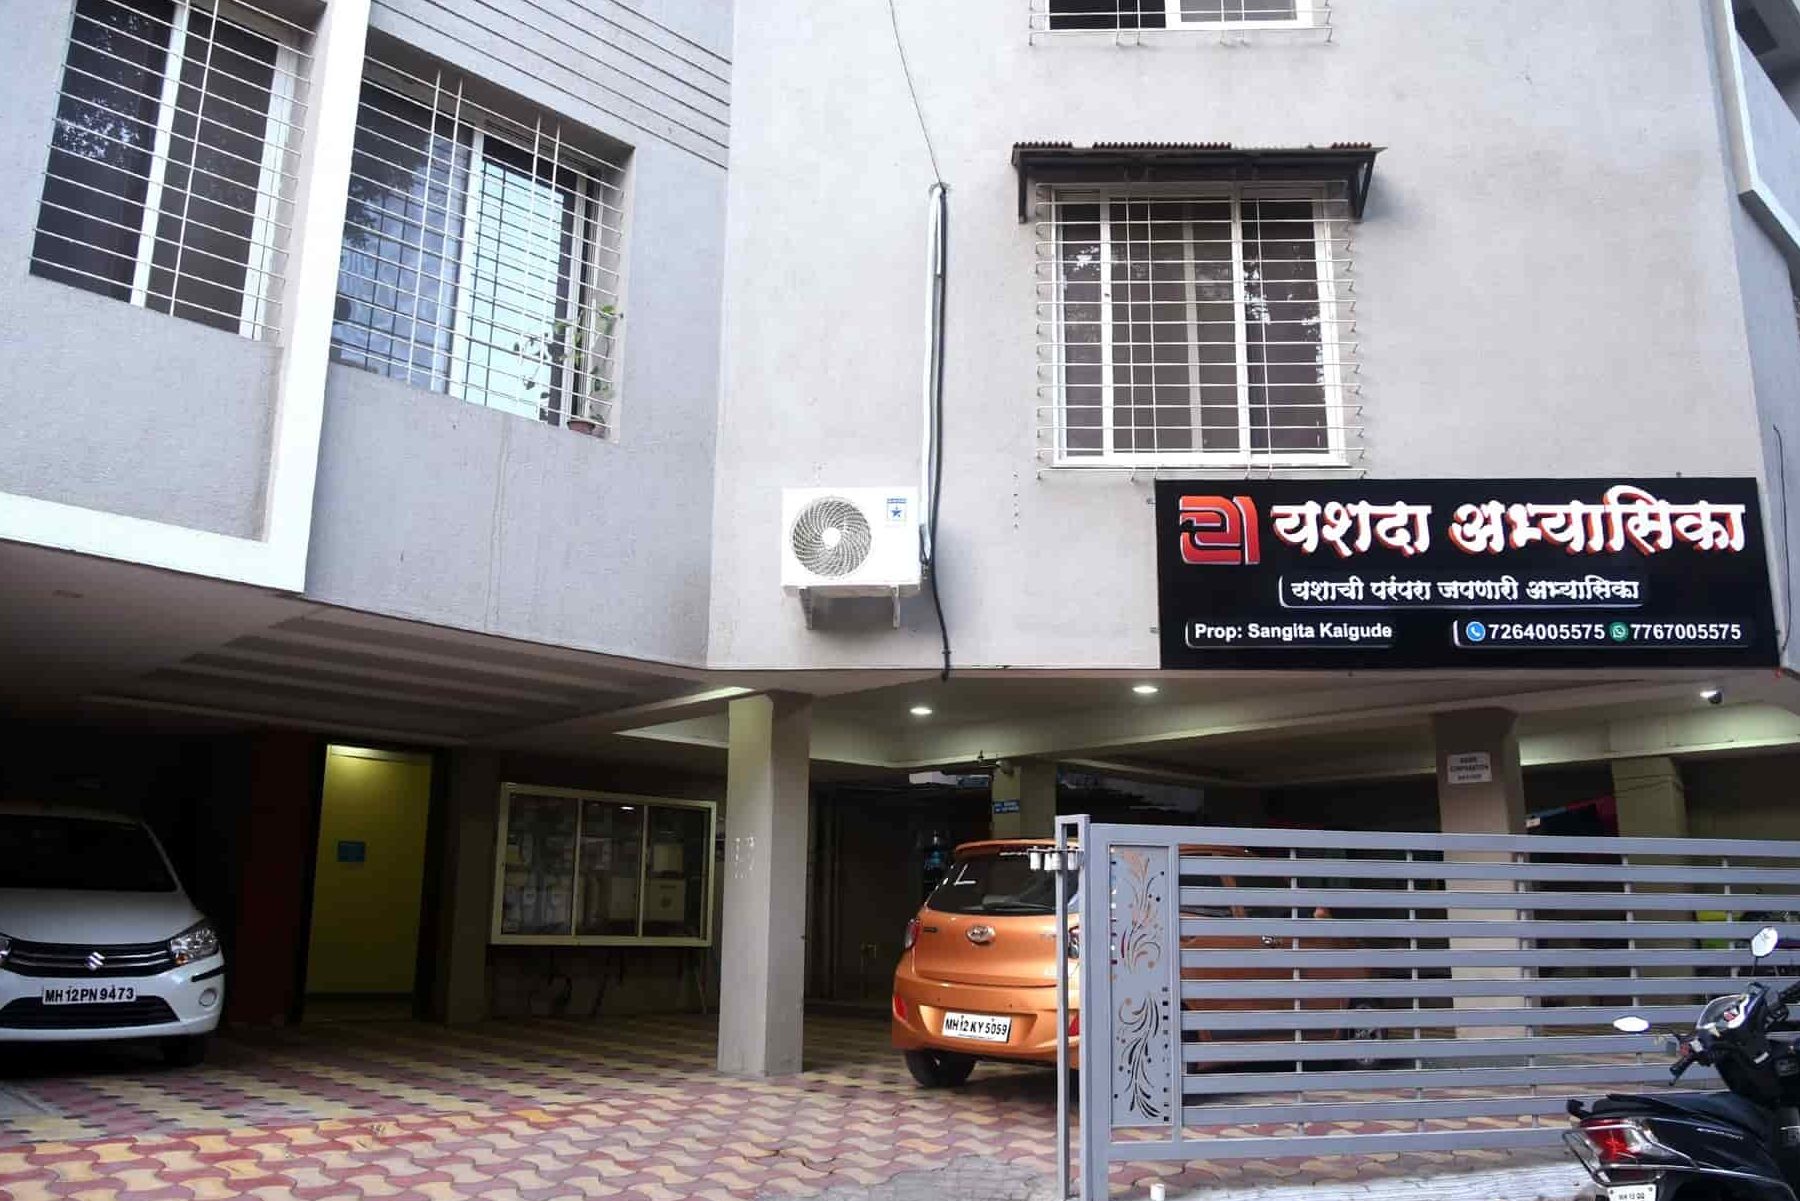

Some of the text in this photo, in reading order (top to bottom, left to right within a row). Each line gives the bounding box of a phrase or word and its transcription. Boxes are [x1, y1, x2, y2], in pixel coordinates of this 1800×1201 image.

[1271, 500, 1432, 557] यशदा
[1449, 485, 1746, 556] अभ्यासिका
[1291, 574, 1639, 603] यशाची परंपरा जपणारी अभ्यासिका
[1194, 623, 1243, 643] Prop:
[1247, 622, 1315, 643] Sangita
[1487, 623, 1742, 640] 7264005575 7767005575
